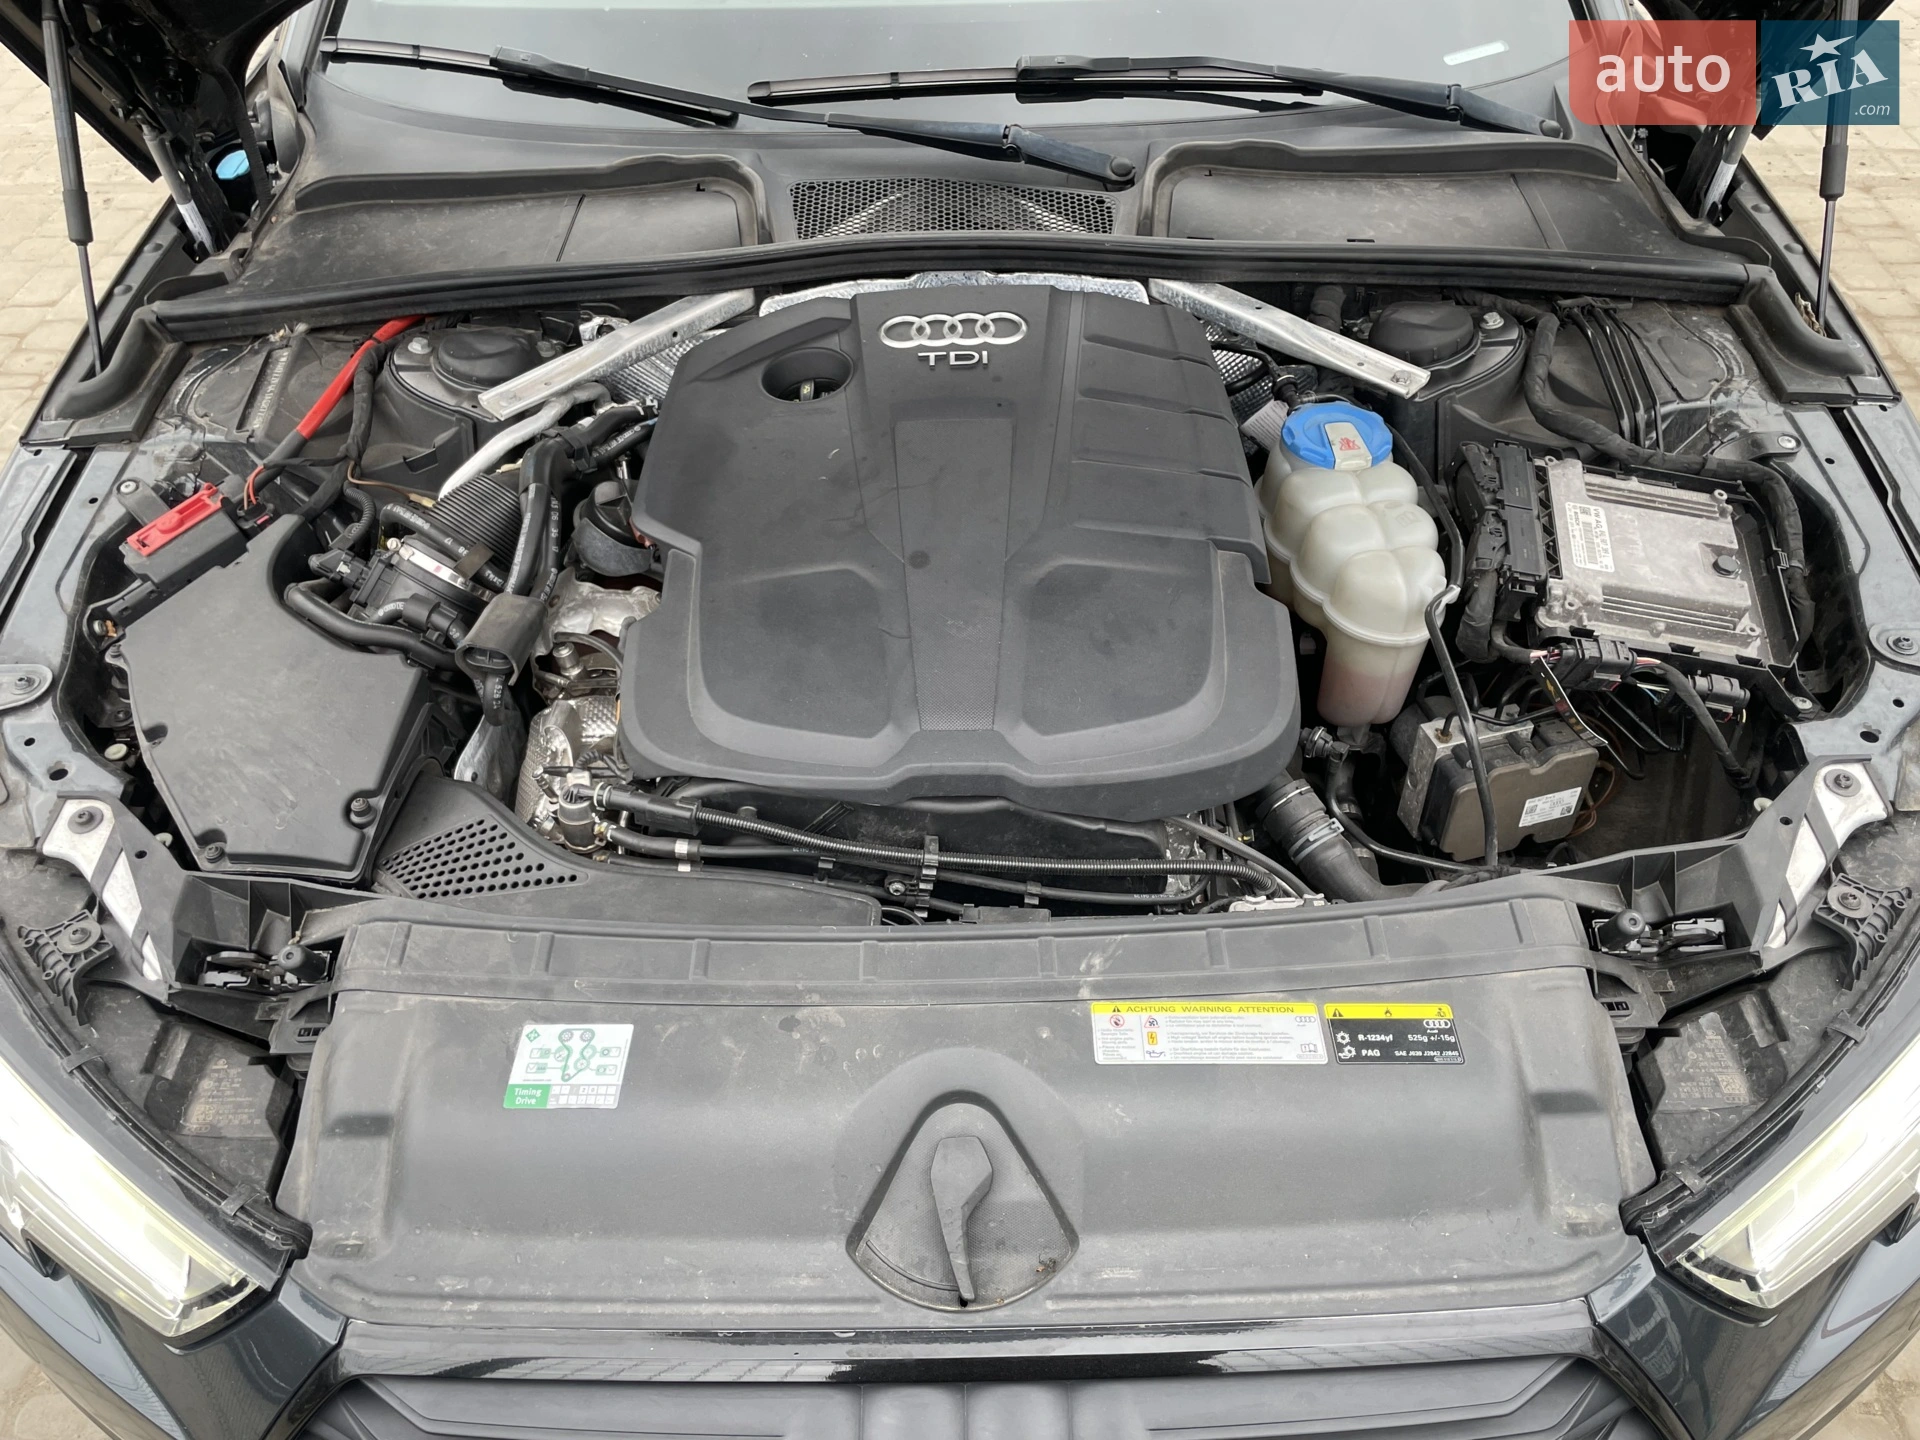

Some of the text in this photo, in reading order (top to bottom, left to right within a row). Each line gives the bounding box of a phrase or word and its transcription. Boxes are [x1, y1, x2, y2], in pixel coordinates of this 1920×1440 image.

[917, 350, 989, 368] TDI
[1126, 1005, 1176, 1013] ACHTUNG
[1181, 1005, 1233, 1013] WARNING
[1407, 1034, 1428, 1043] 525g
[1429, 1034, 1456, 1043] +/-15g
[514, 1087, 542, 1097] Timing
[515, 1096, 537, 1105] Drive
